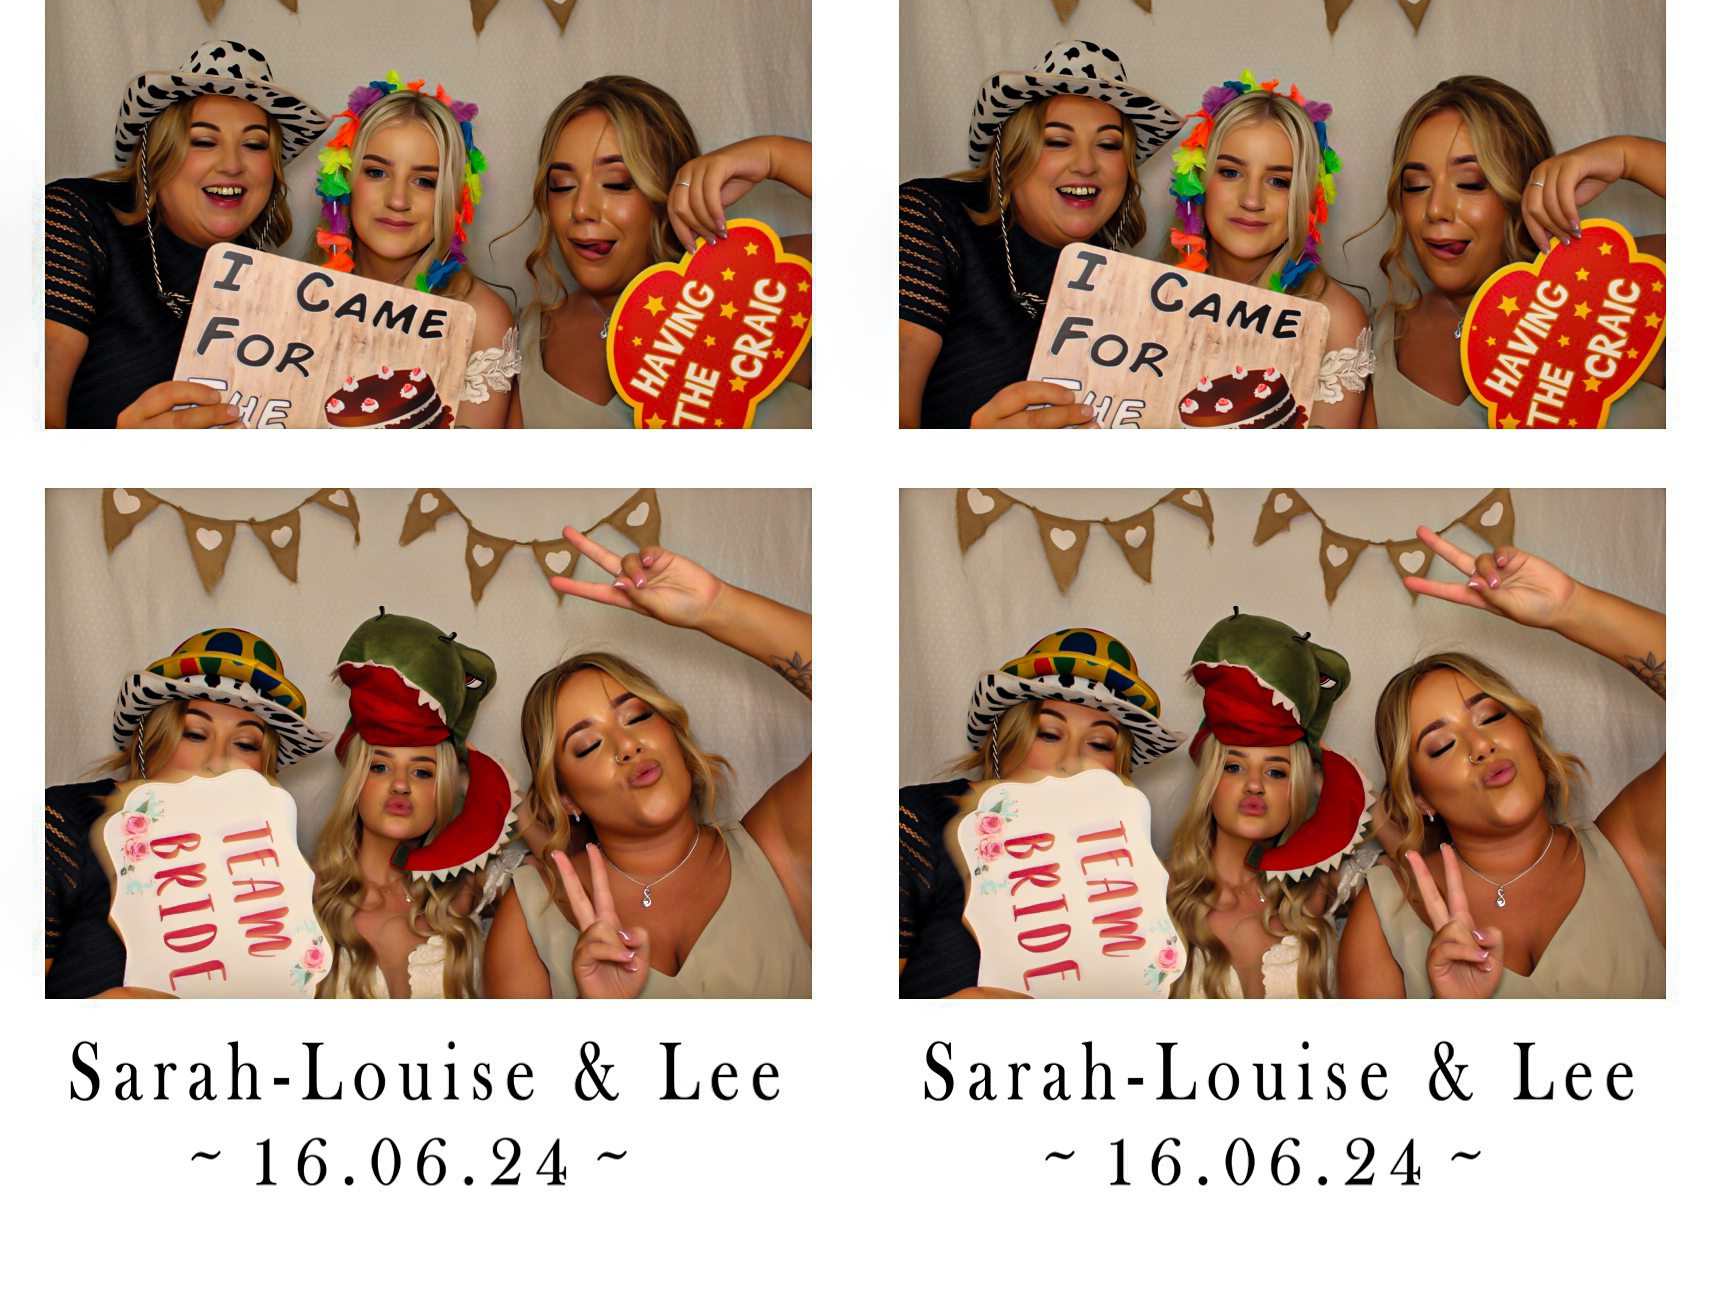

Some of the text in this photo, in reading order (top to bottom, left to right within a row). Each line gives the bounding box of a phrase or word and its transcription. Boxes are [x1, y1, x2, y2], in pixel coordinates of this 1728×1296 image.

[196, 316, 315, 378] FOR
[213, 250, 448, 339] I CAME
[629, 280, 715, 398] HAVING
[672, 278, 787, 427] THE CRAIC
[1050, 316, 1169, 378] FOR
[1067, 250, 1302, 339] I CAME
[1483, 280, 1569, 398] HAVING
[1526, 278, 1641, 427] THE CRAIC
[150, 832, 227, 991] BRIDE
[222, 820, 292, 958] TEAM
[1004, 832, 1081, 991] BRIDE
[1076, 820, 1146, 958] TEAM
